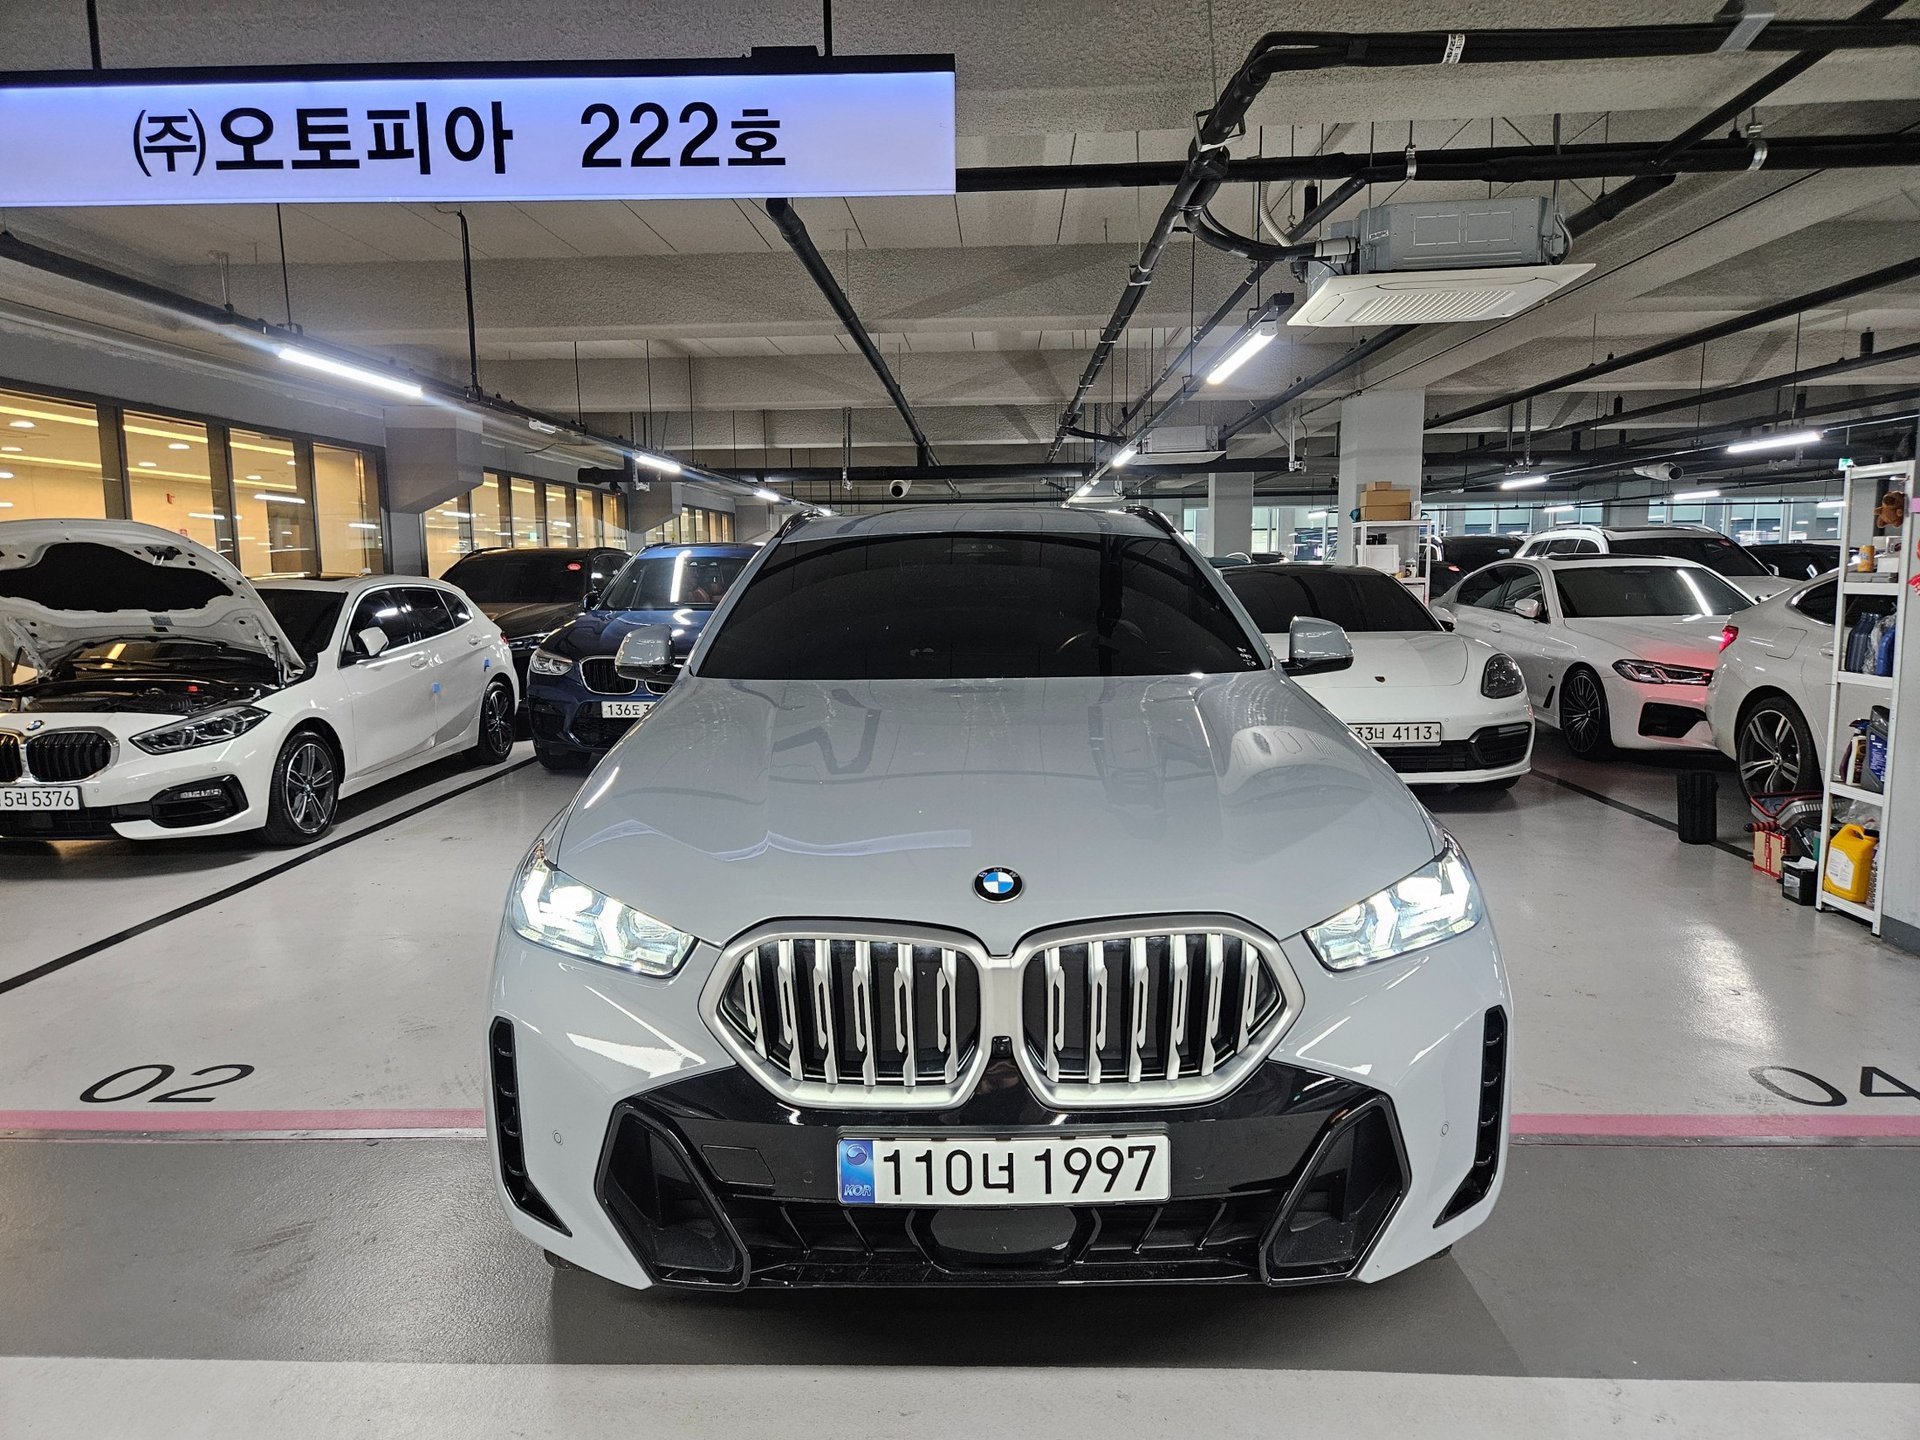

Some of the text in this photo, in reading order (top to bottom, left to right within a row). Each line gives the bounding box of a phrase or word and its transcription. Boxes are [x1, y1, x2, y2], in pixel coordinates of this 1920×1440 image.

[581, 102, 786, 168] 222호
[1392, 726, 1432, 740] 4113
[0, 791, 74, 807] 5러 5376
[80, 1064, 255, 1103] 02
[883, 1145, 1157, 1196] 110너 1997
[843, 1184, 872, 1197] KOR
